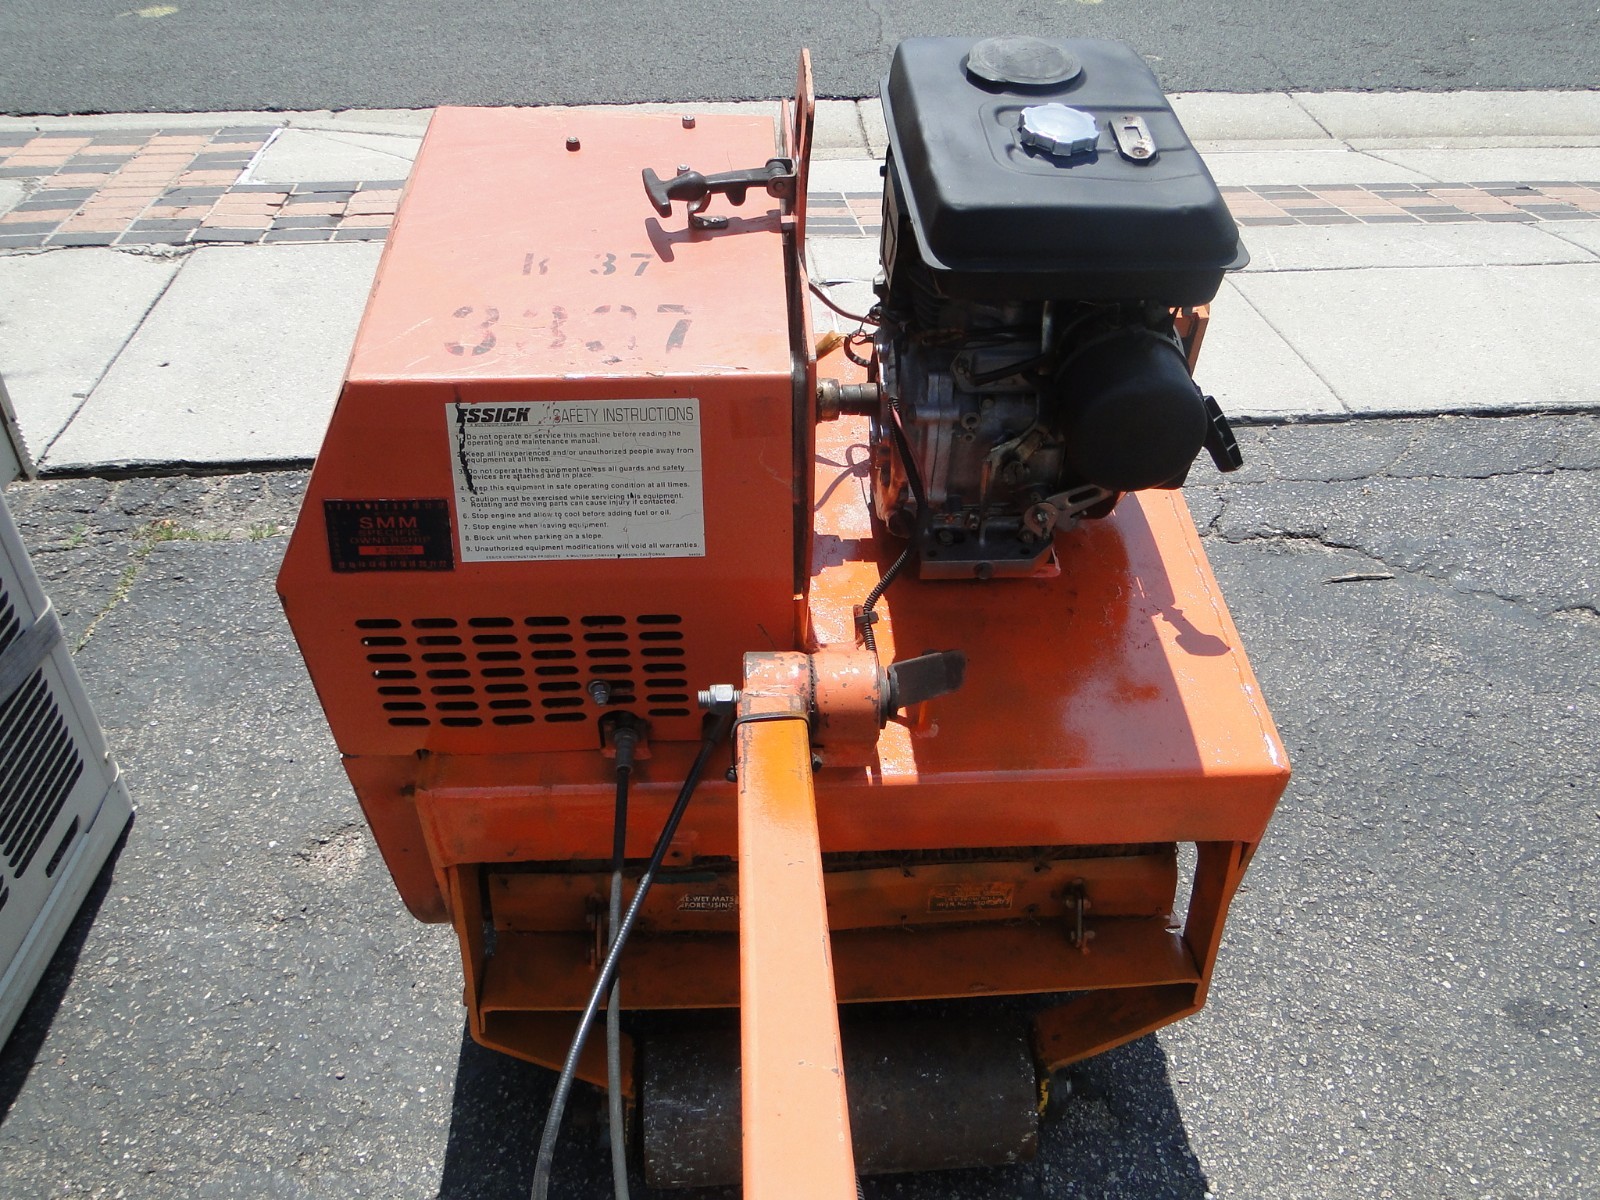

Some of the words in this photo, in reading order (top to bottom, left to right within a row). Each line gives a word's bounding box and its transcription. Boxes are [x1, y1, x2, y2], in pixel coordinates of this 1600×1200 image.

[456, 408, 531, 423] ESSICK
[553, 408, 598, 423] SAFETY
[603, 407, 694, 422] INSTRUCTIONS
[360, 516, 417, 529] SMM
